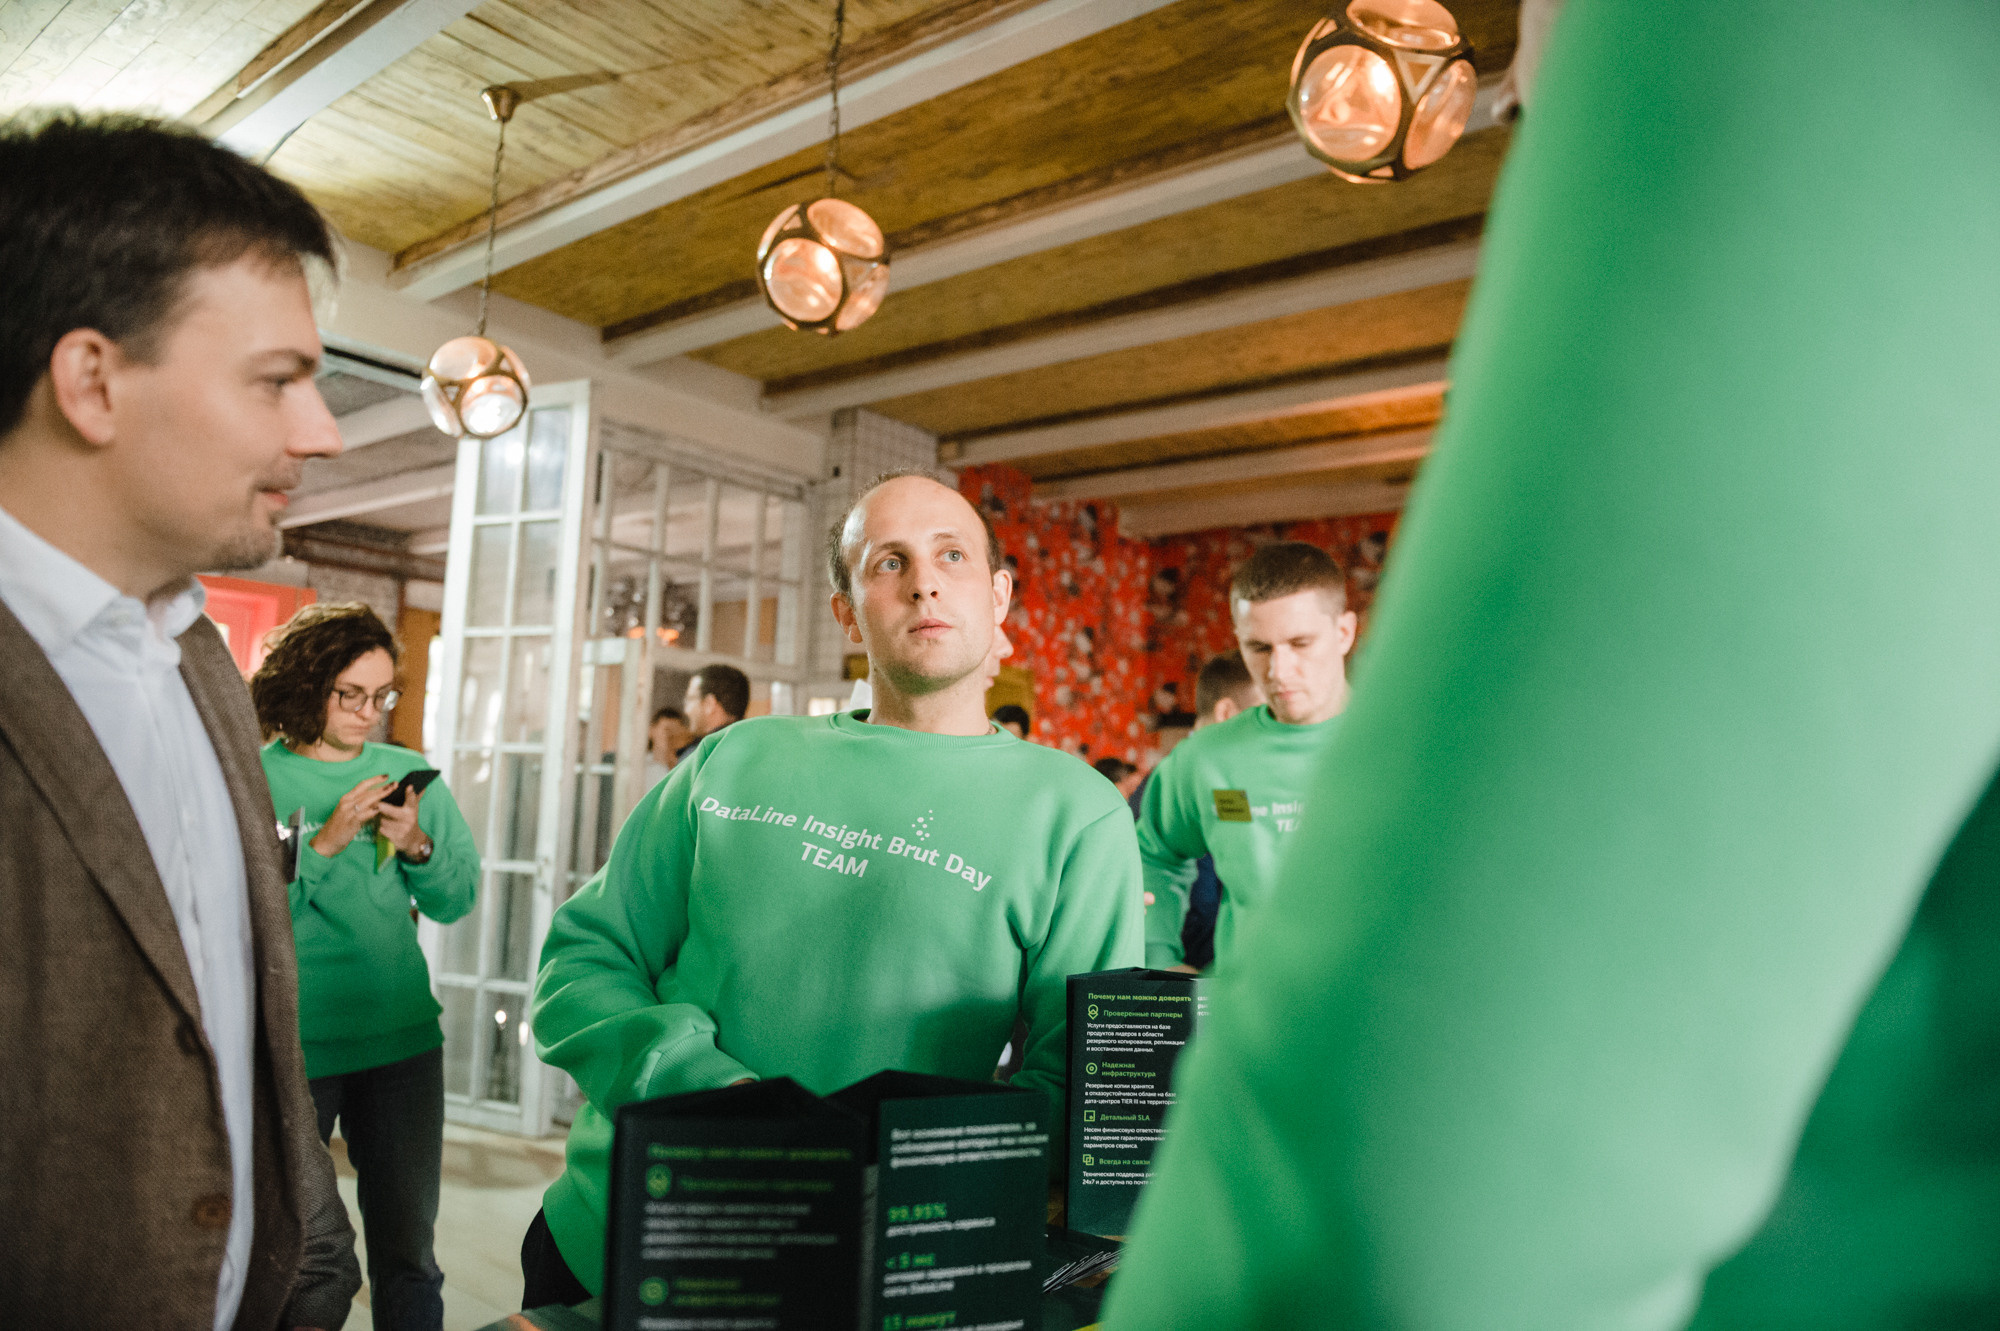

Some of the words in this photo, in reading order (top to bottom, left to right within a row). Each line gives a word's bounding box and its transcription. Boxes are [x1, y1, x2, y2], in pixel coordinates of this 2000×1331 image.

[700, 796, 797, 827] DataLine
[802, 815, 883, 850] Insight
[886, 836, 940, 866] Brut
[944, 853, 992, 891] Day
[801, 841, 869, 877] TEAM
[1088, 993, 1115, 1001] Почему
[1103, 1010, 1149, 1018] Проверенные
